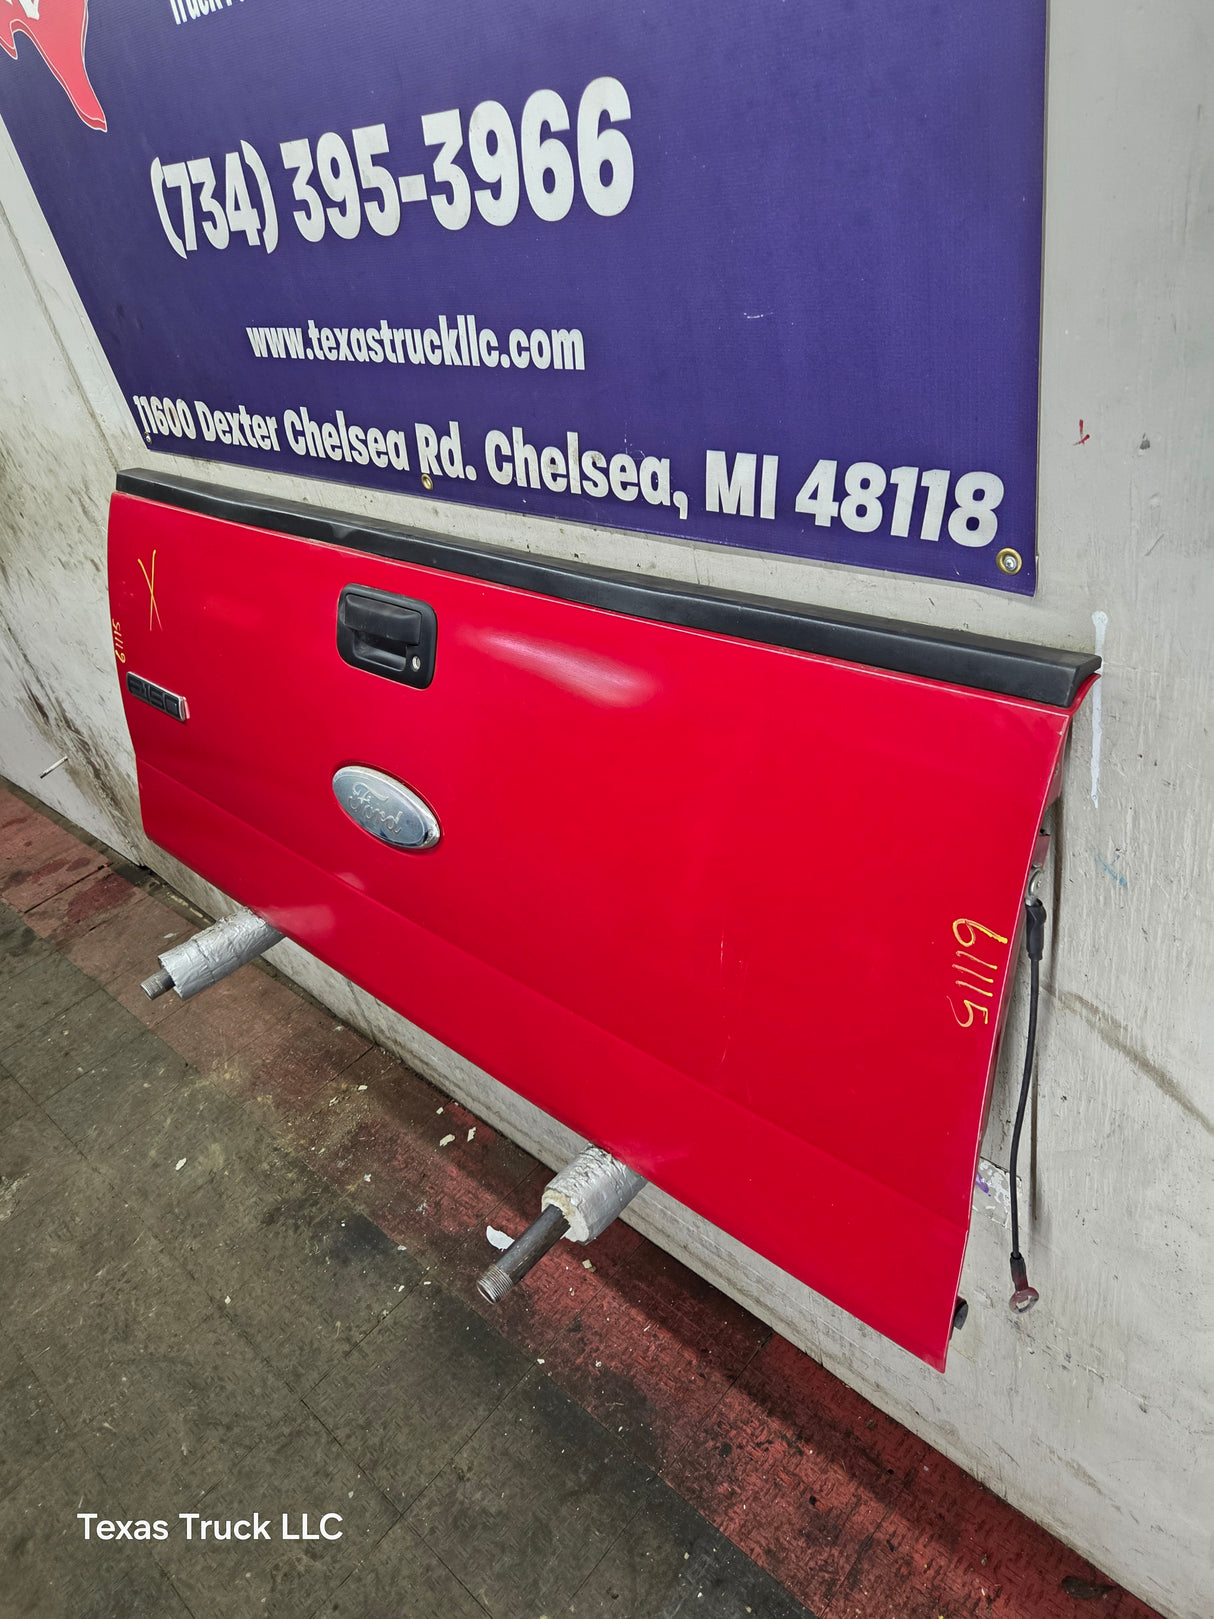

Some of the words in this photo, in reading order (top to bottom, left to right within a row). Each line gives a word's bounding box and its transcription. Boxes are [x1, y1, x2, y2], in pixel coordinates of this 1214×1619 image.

[150, 139, 279, 259] (734)
[279, 76, 635, 243] 395-3966
[245, 314, 586, 371] www.texastruckllc.com
[132, 395, 197, 440] 11600
[193, 400, 281, 452] Dexter
[283, 406, 410, 473] Chelsea
[414, 421, 477, 480] Rd.
[484, 430, 689, 520] Chelsea,
[705, 449, 779, 520] MI
[794, 459, 1005, 548] 48118
[347, 781, 403, 834] Ford
[946, 918, 1008, 1028] 61115
